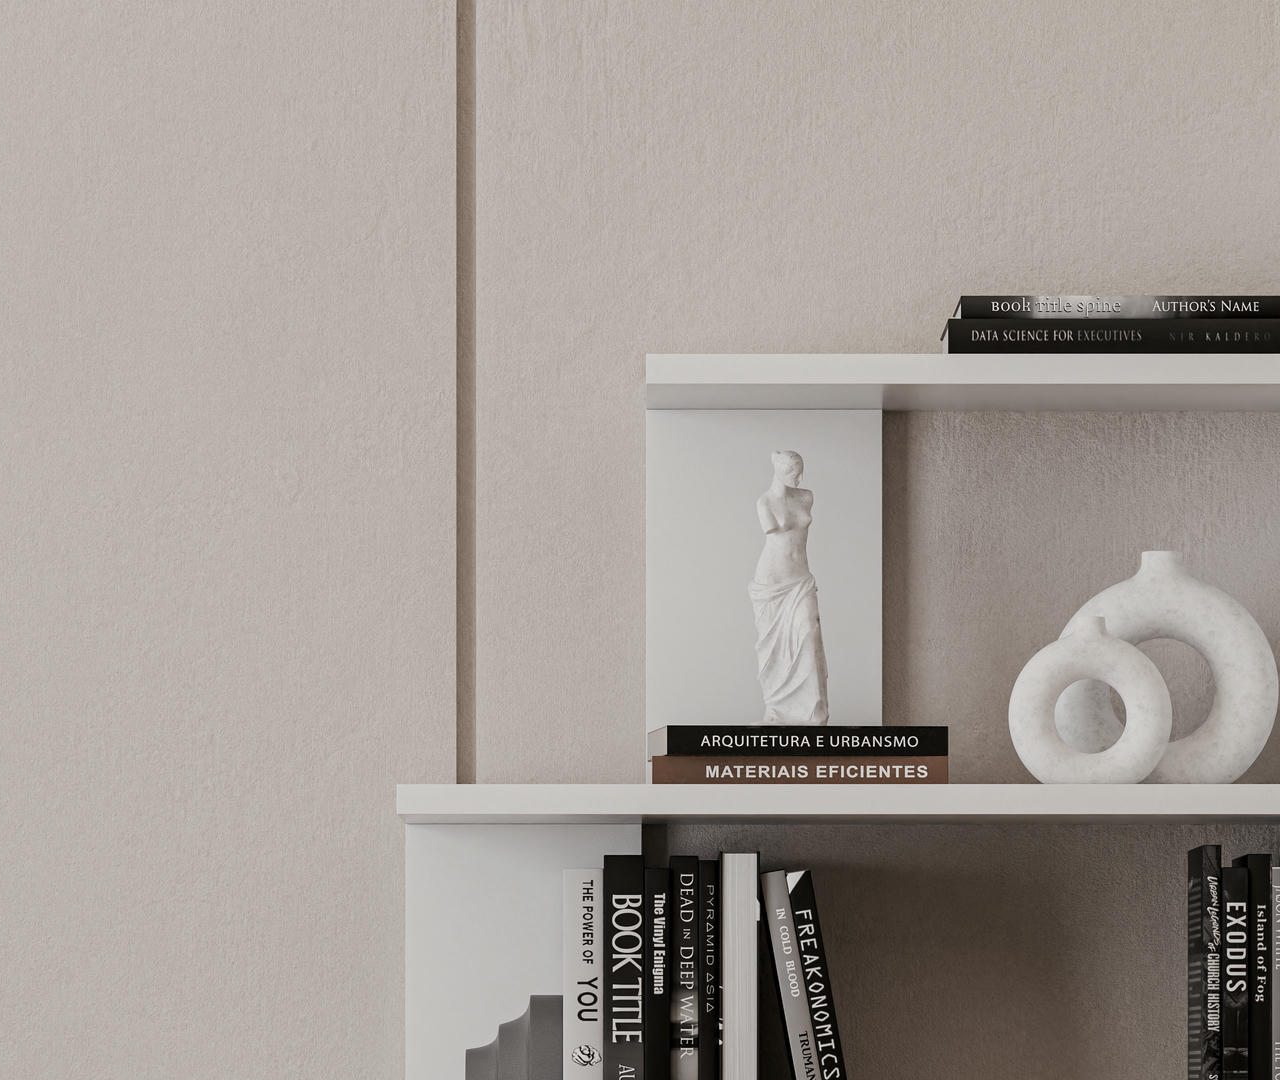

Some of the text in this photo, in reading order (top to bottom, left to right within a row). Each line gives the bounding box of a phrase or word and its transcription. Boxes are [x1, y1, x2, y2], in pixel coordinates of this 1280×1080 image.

[971, 330, 1142, 342] DATA SCIENCE FOR EXECUTIVES
[1221, 300, 1259, 312] NAME
[701, 735, 919, 748] ARQUITETURA E URBANSMO
[705, 765, 928, 778] MATERIAIS EFICIENTES
[577, 880, 598, 1021] THE POWER OF YOU
[612, 894, 642, 1043] BOOK TITLE
[653, 893, 665, 995] The Vinyl Enigma
[680, 873, 693, 1058] DEAD IN DEEP WATER
[706, 885, 714, 1013] PYRAMID ASIA
[776, 907, 800, 997] IN COLD BLOOD
[1207, 953, 1220, 990] CHURCH
[1226, 902, 1247, 992] EXODUS
[1255, 904, 1267, 1002] Island of Fog
[795, 909, 840, 1080] FREAKONOMICS
[1207, 994, 1220, 1032] HISTORY
